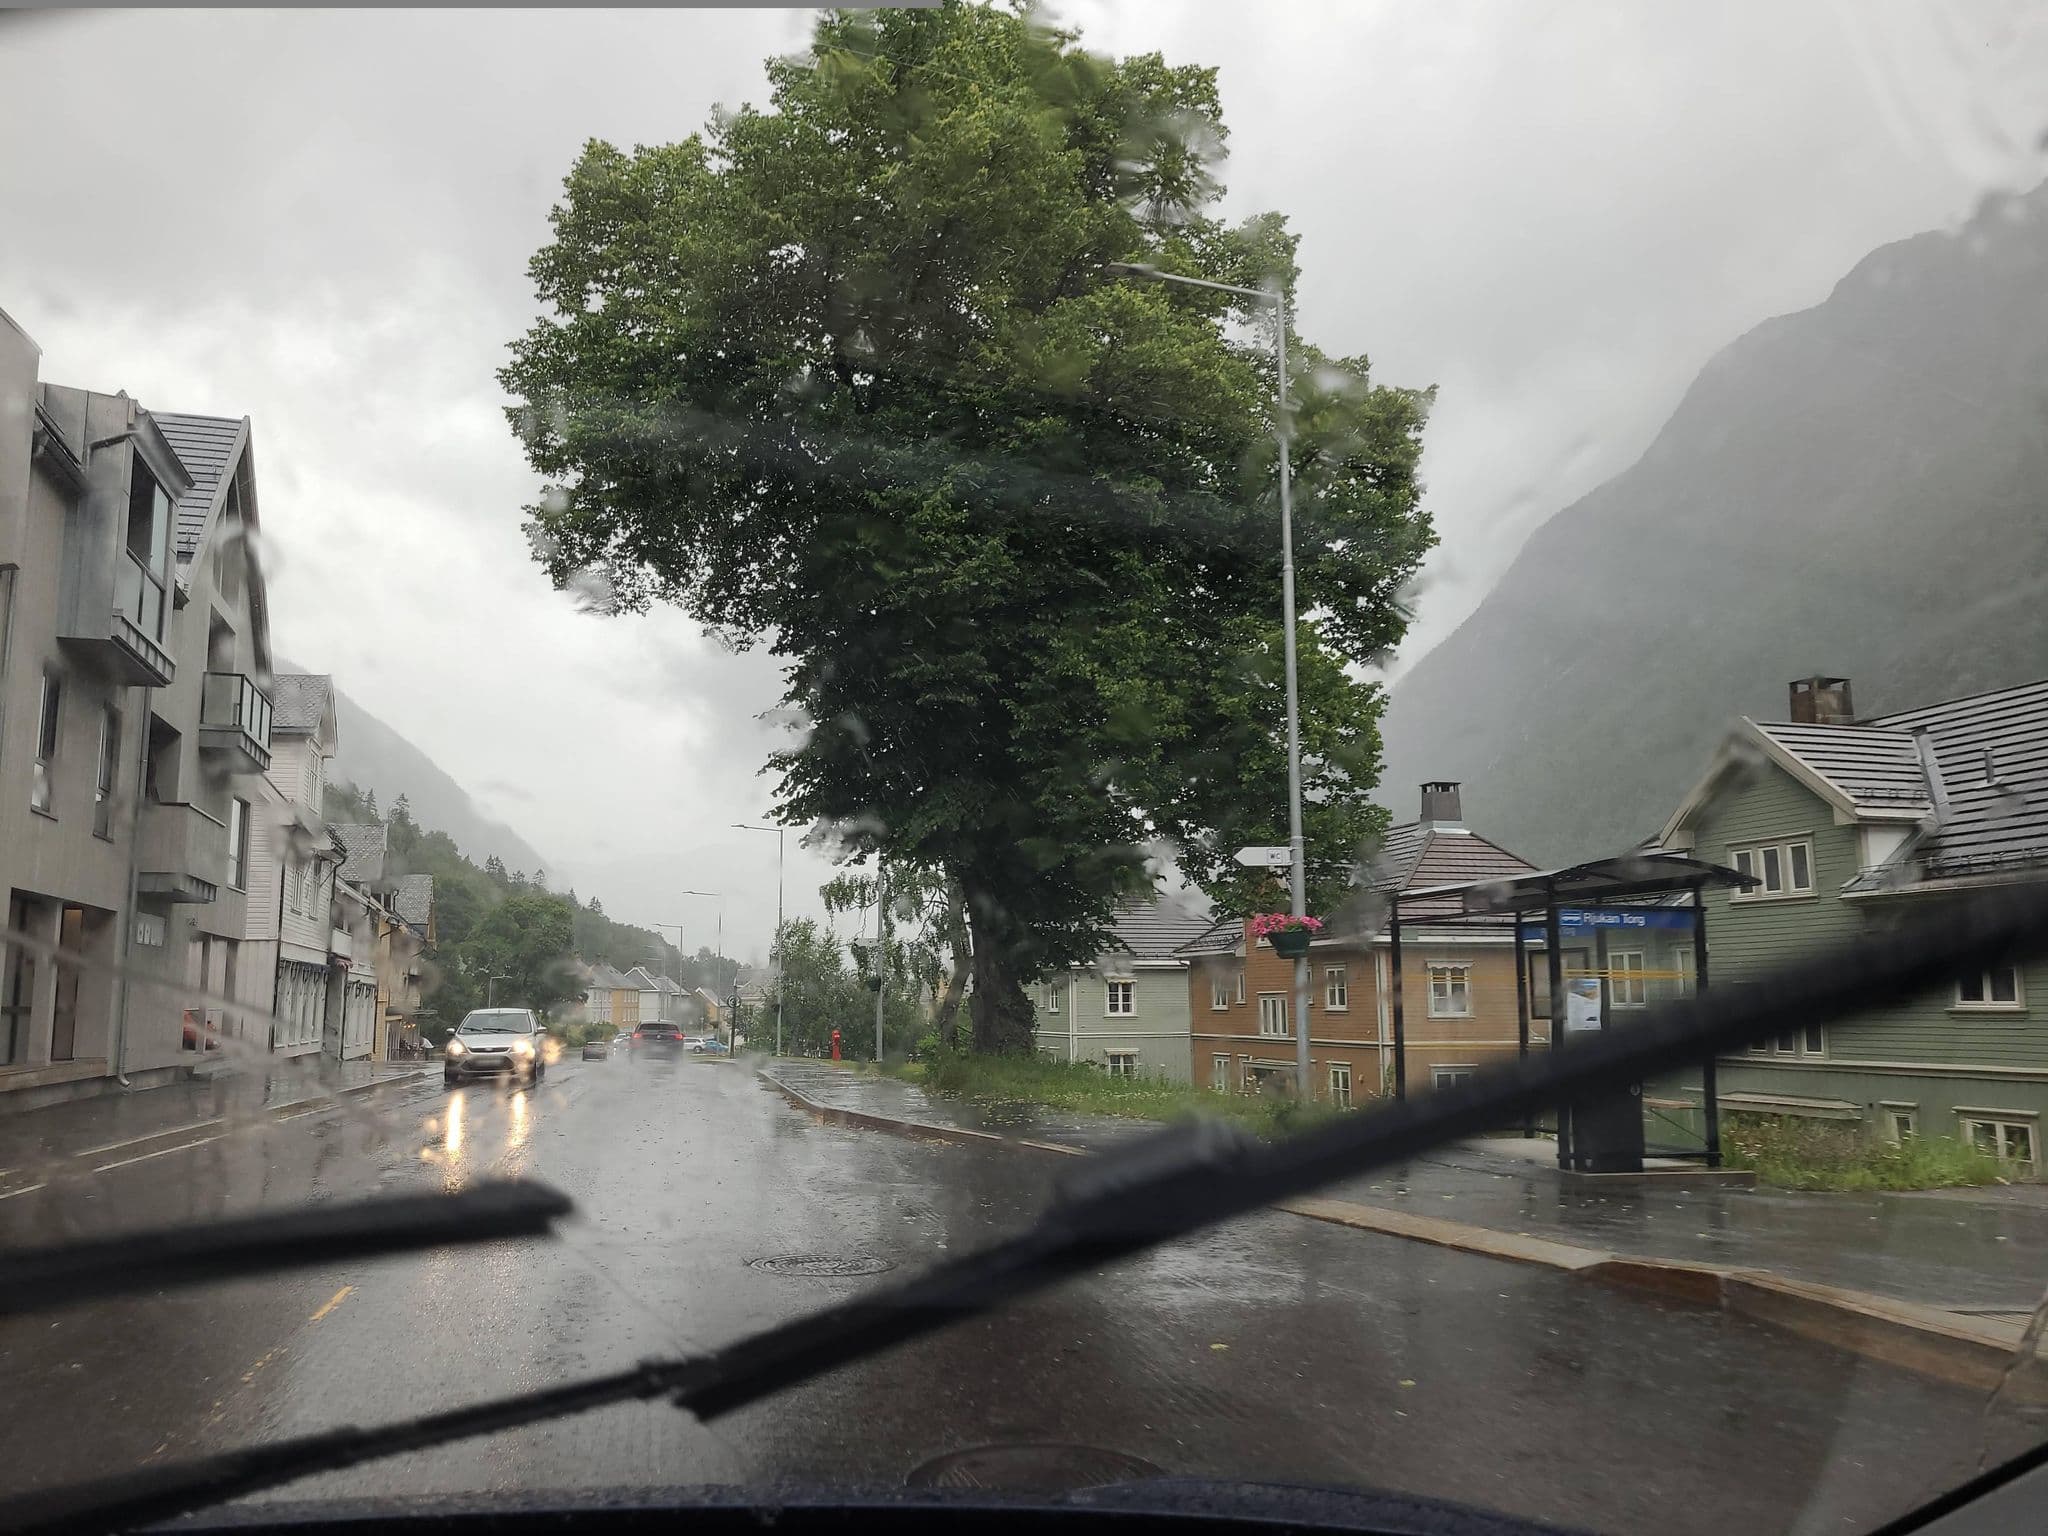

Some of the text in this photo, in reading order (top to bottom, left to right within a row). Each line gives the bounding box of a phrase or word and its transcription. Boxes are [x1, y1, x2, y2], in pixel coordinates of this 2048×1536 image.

[1270, 852, 1281, 860] WC
[1583, 912, 1646, 927] Rjukan Torg
